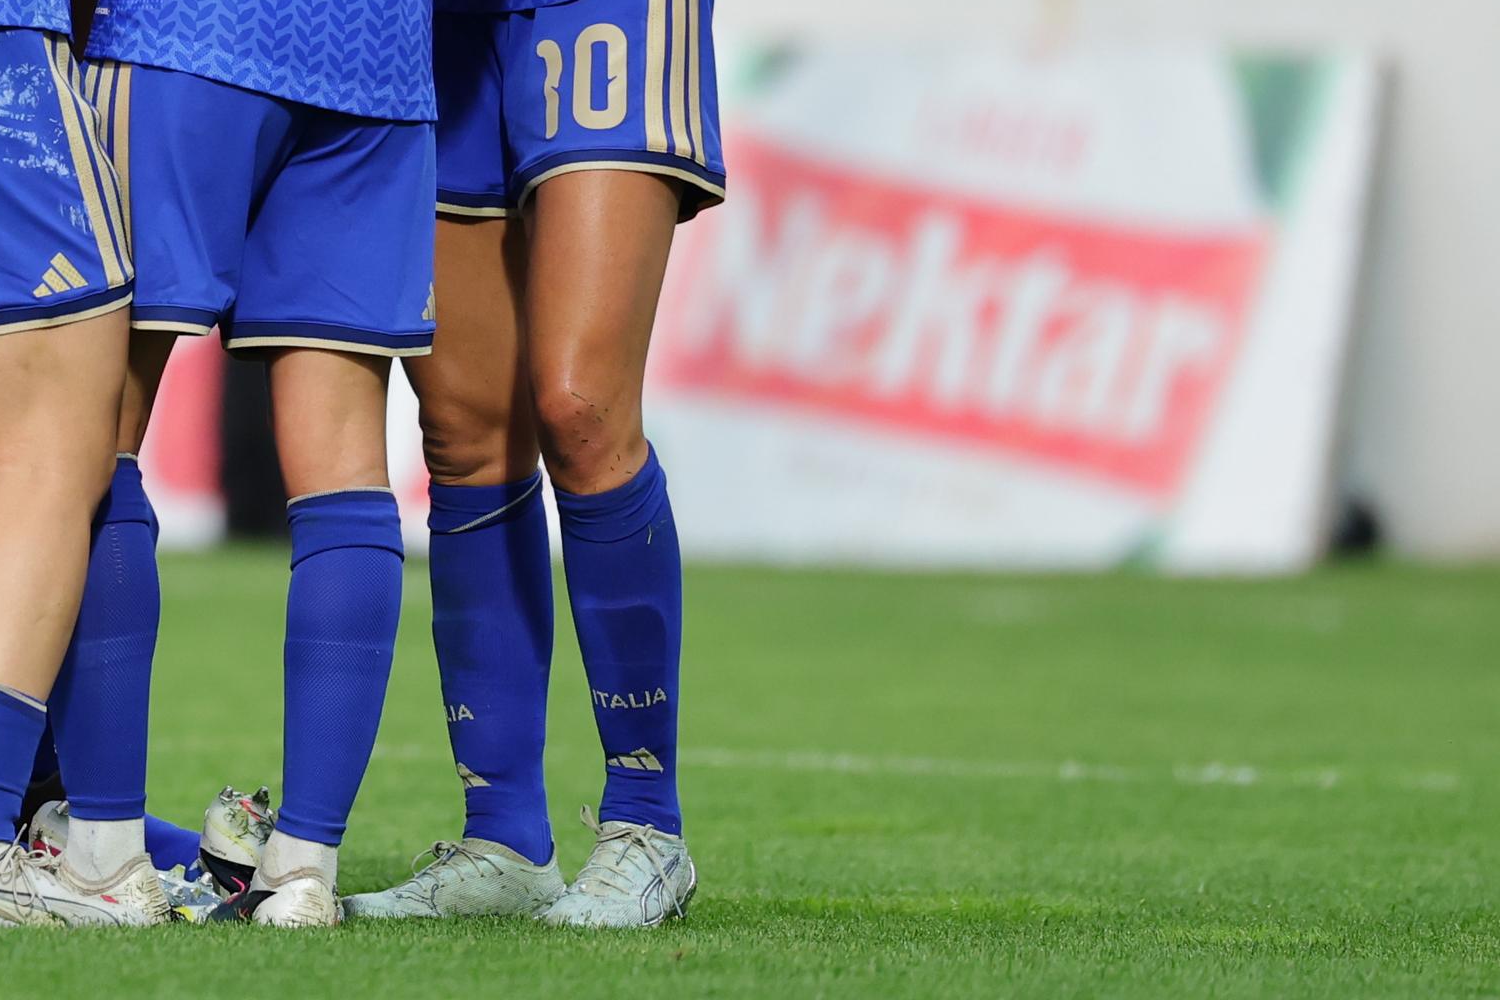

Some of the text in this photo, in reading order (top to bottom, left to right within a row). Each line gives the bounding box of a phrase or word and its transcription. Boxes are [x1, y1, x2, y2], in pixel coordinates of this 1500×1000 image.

[536, 22, 628, 140] 10
[685, 185, 1224, 446] Nektar
[591, 687, 667, 710] ITALIA
